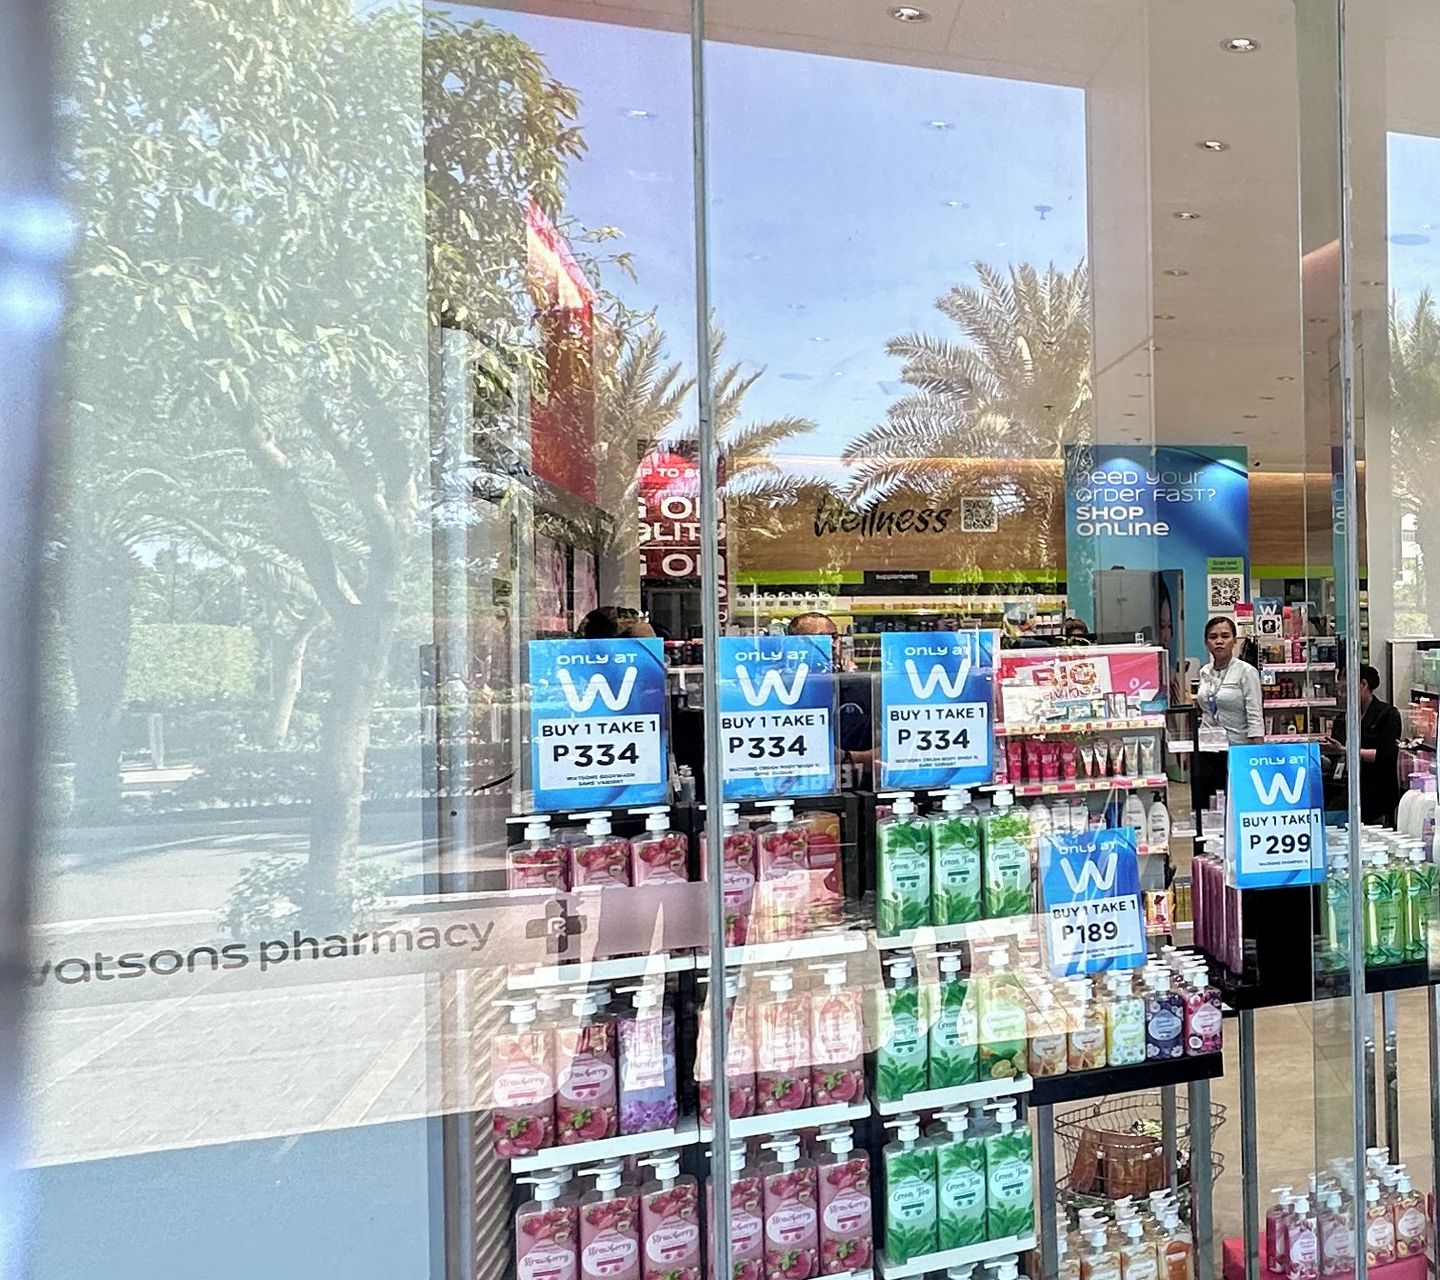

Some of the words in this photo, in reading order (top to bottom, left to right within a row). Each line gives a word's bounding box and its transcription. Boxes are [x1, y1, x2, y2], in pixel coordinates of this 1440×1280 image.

[1076, 506, 1144, 520] SHOP
[557, 666, 638, 712] W
[736, 664, 808, 706] W
[905, 658, 972, 700] W
[722, 717, 754, 729] BUY
[761, 717, 767, 727] 1
[775, 715, 814, 727] TAKE
[820, 714, 825, 726] 1
[890, 710, 920, 721] BUY
[925, 709, 930, 720] 1
[937, 708, 975, 719] TAKE
[979, 707, 984, 718] 1
[542, 723, 579, 737] BUY
[585, 722, 592, 734] 1
[600, 721, 643, 734] TAKE
[650, 720, 656, 732] 1
[898, 728, 970, 751] P334
[553, 743, 640, 767] P334
[729, 735, 807, 759] P334
[1251, 767, 1306, 806] W
[1243, 816, 1268, 828] BUY
[1272, 816, 1277, 826] 1
[1281, 814, 1312, 826] TAKE
[1314, 812, 1319, 823] 1
[1250, 833, 1311, 855] P299
[1060, 853, 1118, 893] W
[1053, 907, 1079, 920] BUY
[1083, 905, 1088, 916] 1
[1092, 902, 1127, 915] TAKE
[1130, 899, 1135, 910] 1
[260, 918, 494, 971] pharmacy
[1062, 921, 1118, 945] P189
